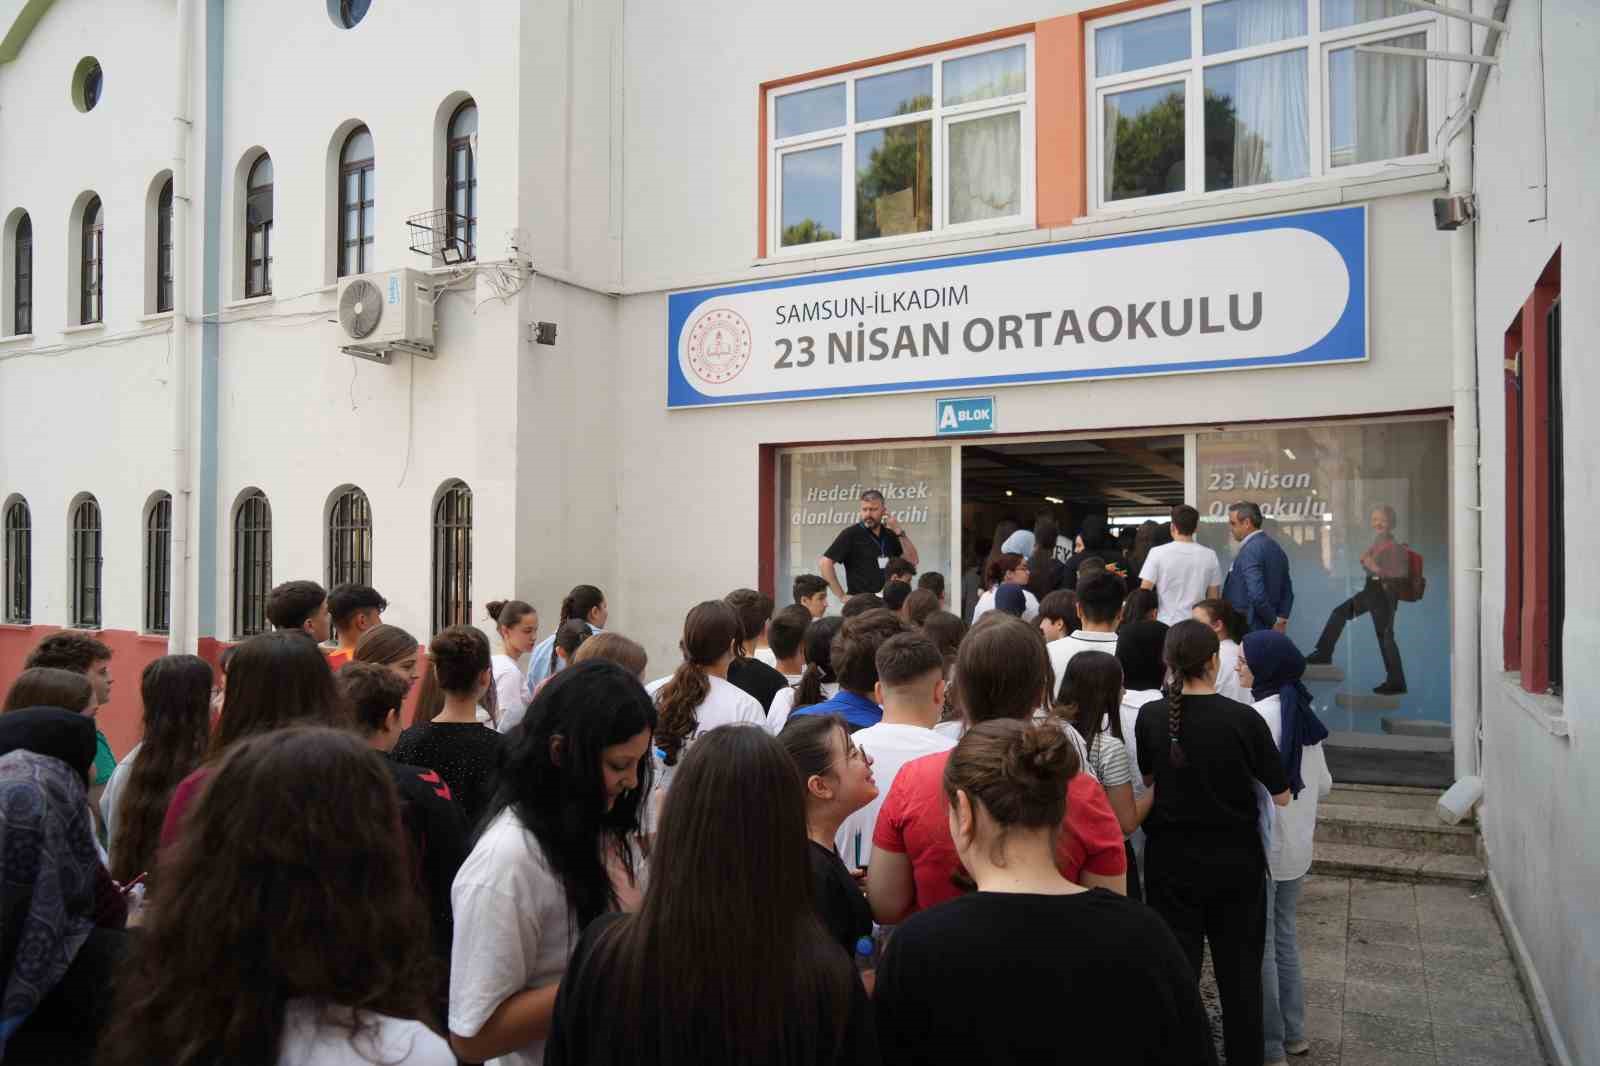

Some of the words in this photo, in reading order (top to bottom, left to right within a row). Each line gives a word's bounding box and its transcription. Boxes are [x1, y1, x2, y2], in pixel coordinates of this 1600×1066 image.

[776, 284, 969, 325] SAMSUN-İLKADIM
[774, 335, 816, 369] 23
[827, 321, 949, 364] NİSAN
[962, 291, 1263, 353] ORTAOKULU
[940, 404, 959, 429] A
[959, 408, 990, 422] BLOK
[807, 483, 861, 502] Hedefi
[868, 481, 928, 500] üksek
[1208, 473, 1235, 491] 23
[1243, 470, 1310, 489] Nisan
[1209, 496, 1327, 519] Orokulu
